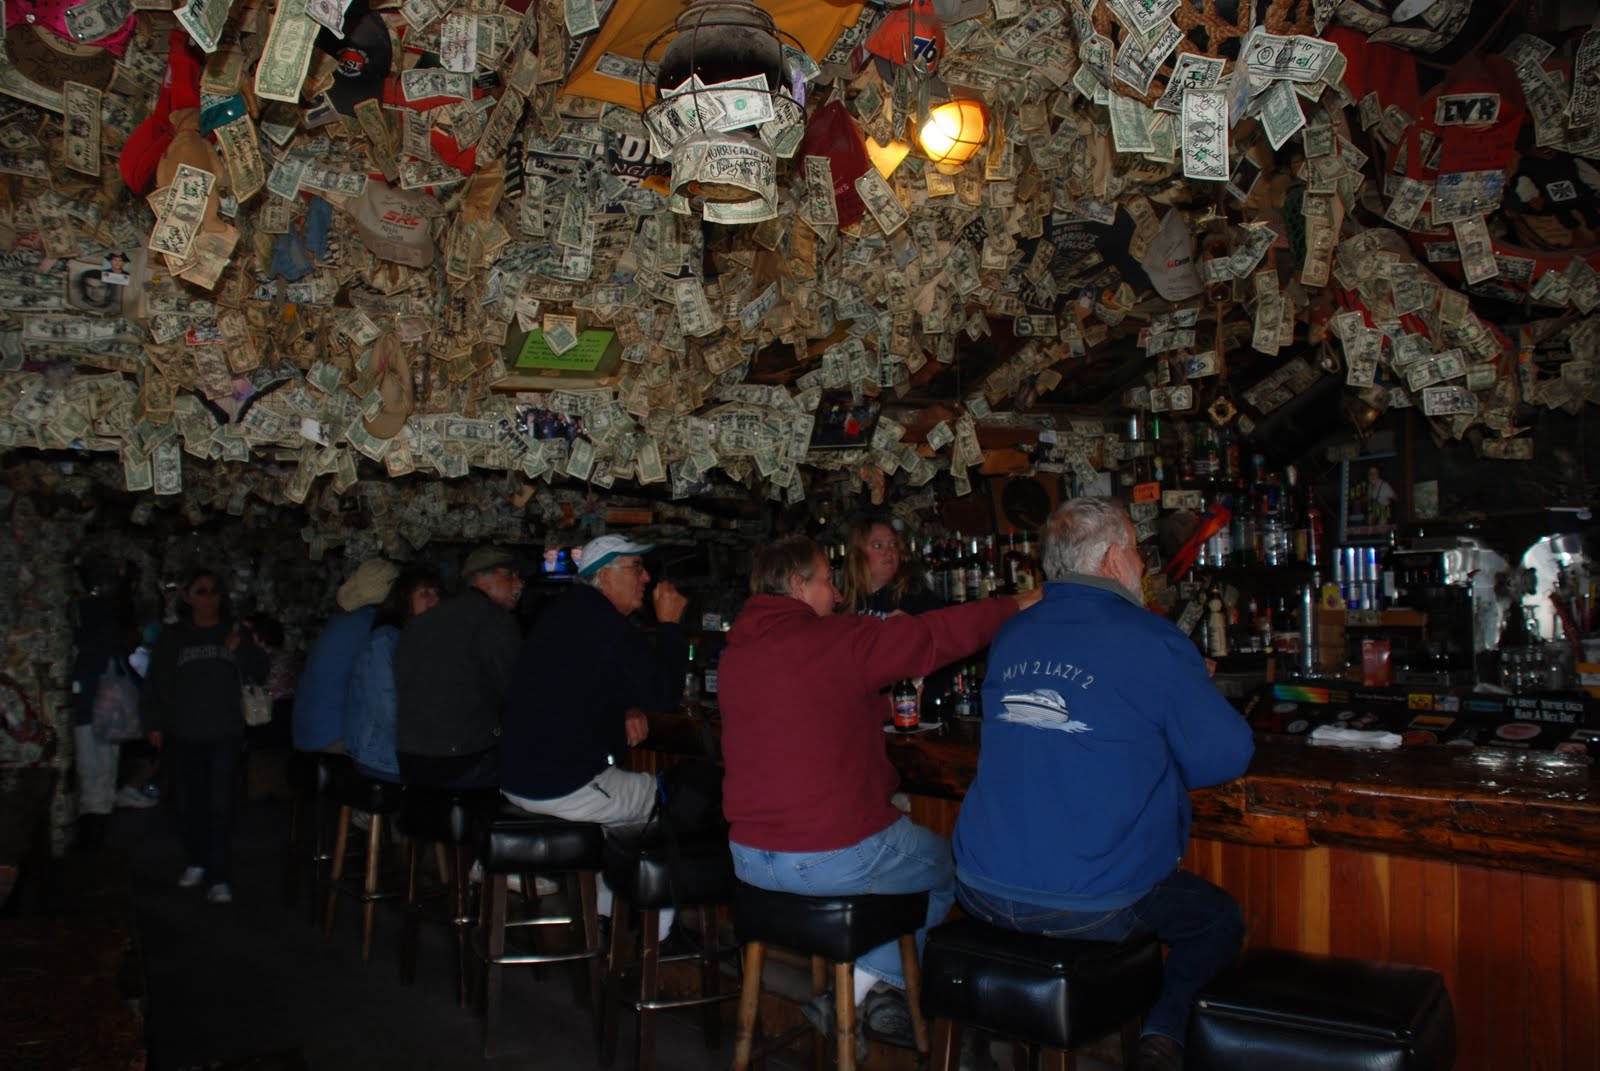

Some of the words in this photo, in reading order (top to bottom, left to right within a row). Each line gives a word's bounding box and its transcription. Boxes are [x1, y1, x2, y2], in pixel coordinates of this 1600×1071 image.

[913, 36, 937, 62] 76
[705, 144, 758, 163] HURRICANE
[1003, 661, 1028, 682] M/V
[1033, 661, 1041, 675] 2
[1045, 660, 1083, 681] LAZY
[1081, 675, 1094, 689] 2
